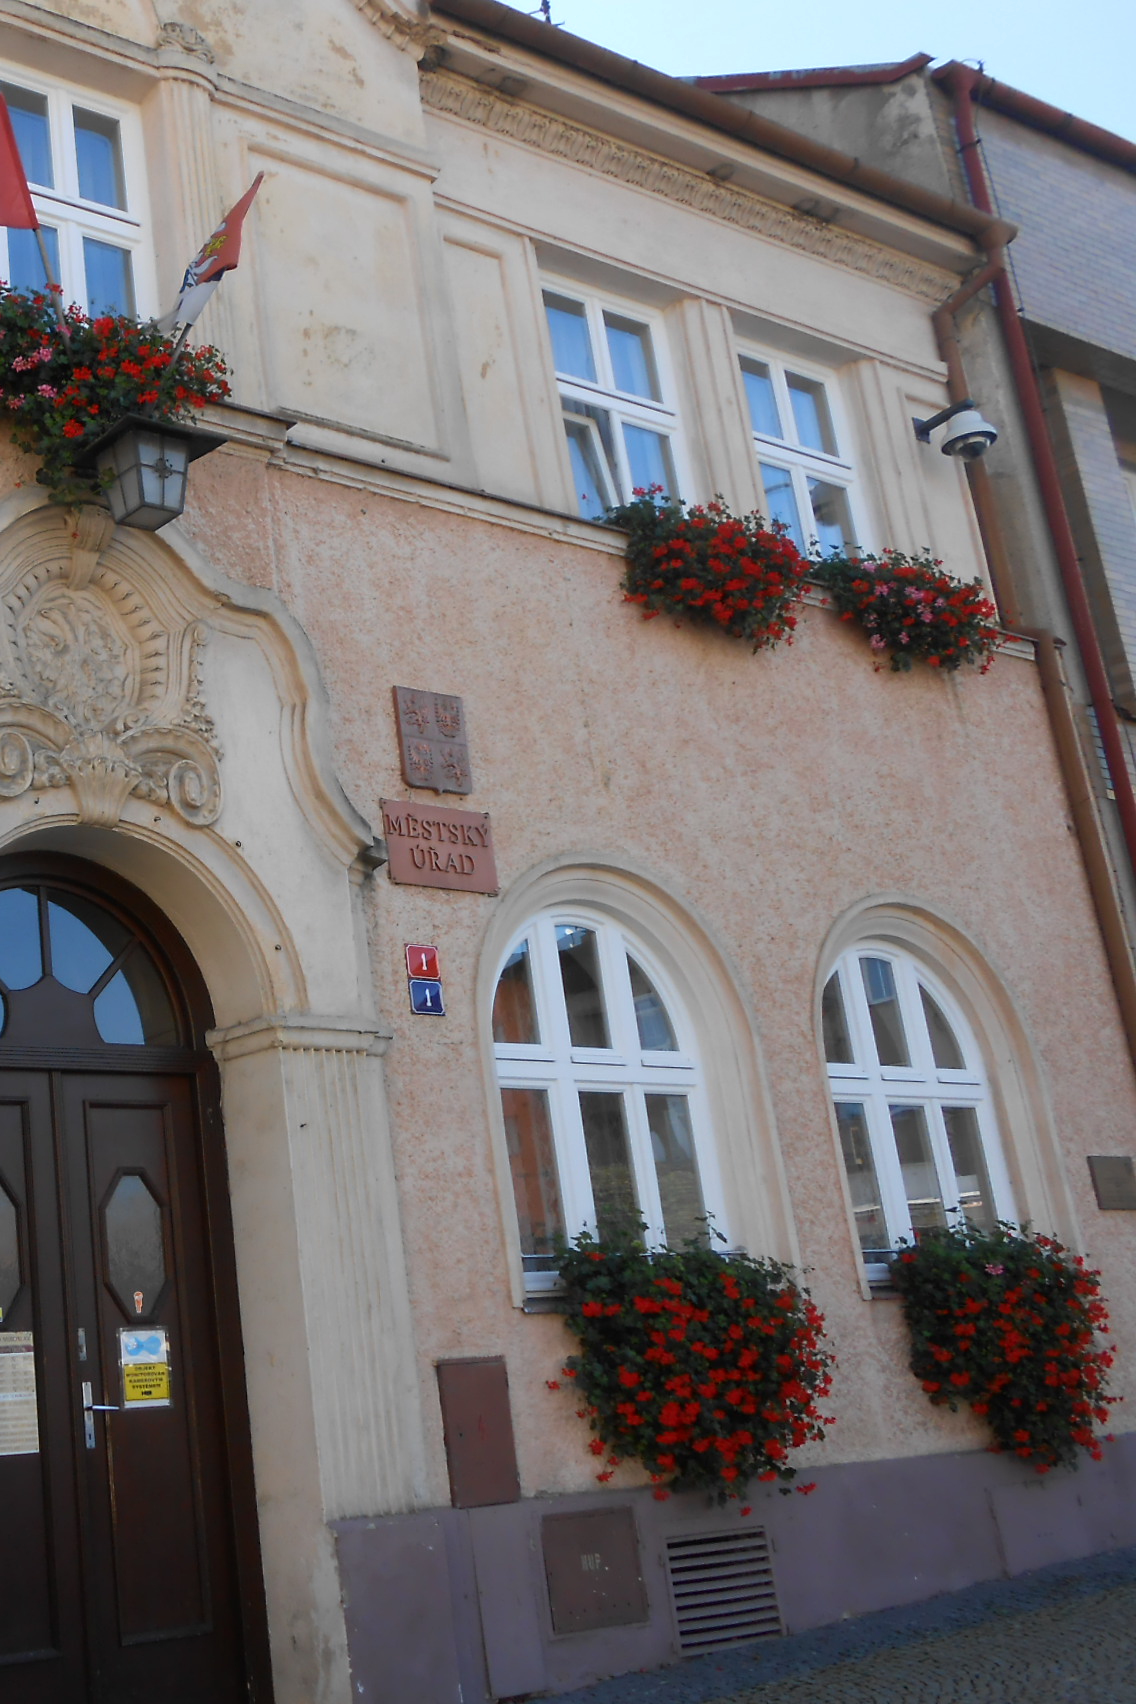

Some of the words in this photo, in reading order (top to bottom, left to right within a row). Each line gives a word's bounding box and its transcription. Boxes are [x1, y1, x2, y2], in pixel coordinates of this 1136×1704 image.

[385, 813, 488, 848] MĚSTSKÝ
[409, 844, 475, 875] ÚŘAD
[420, 952, 428, 971] 1
[425, 988, 432, 1007] 1
[580, 1552, 601, 1570] HUP
